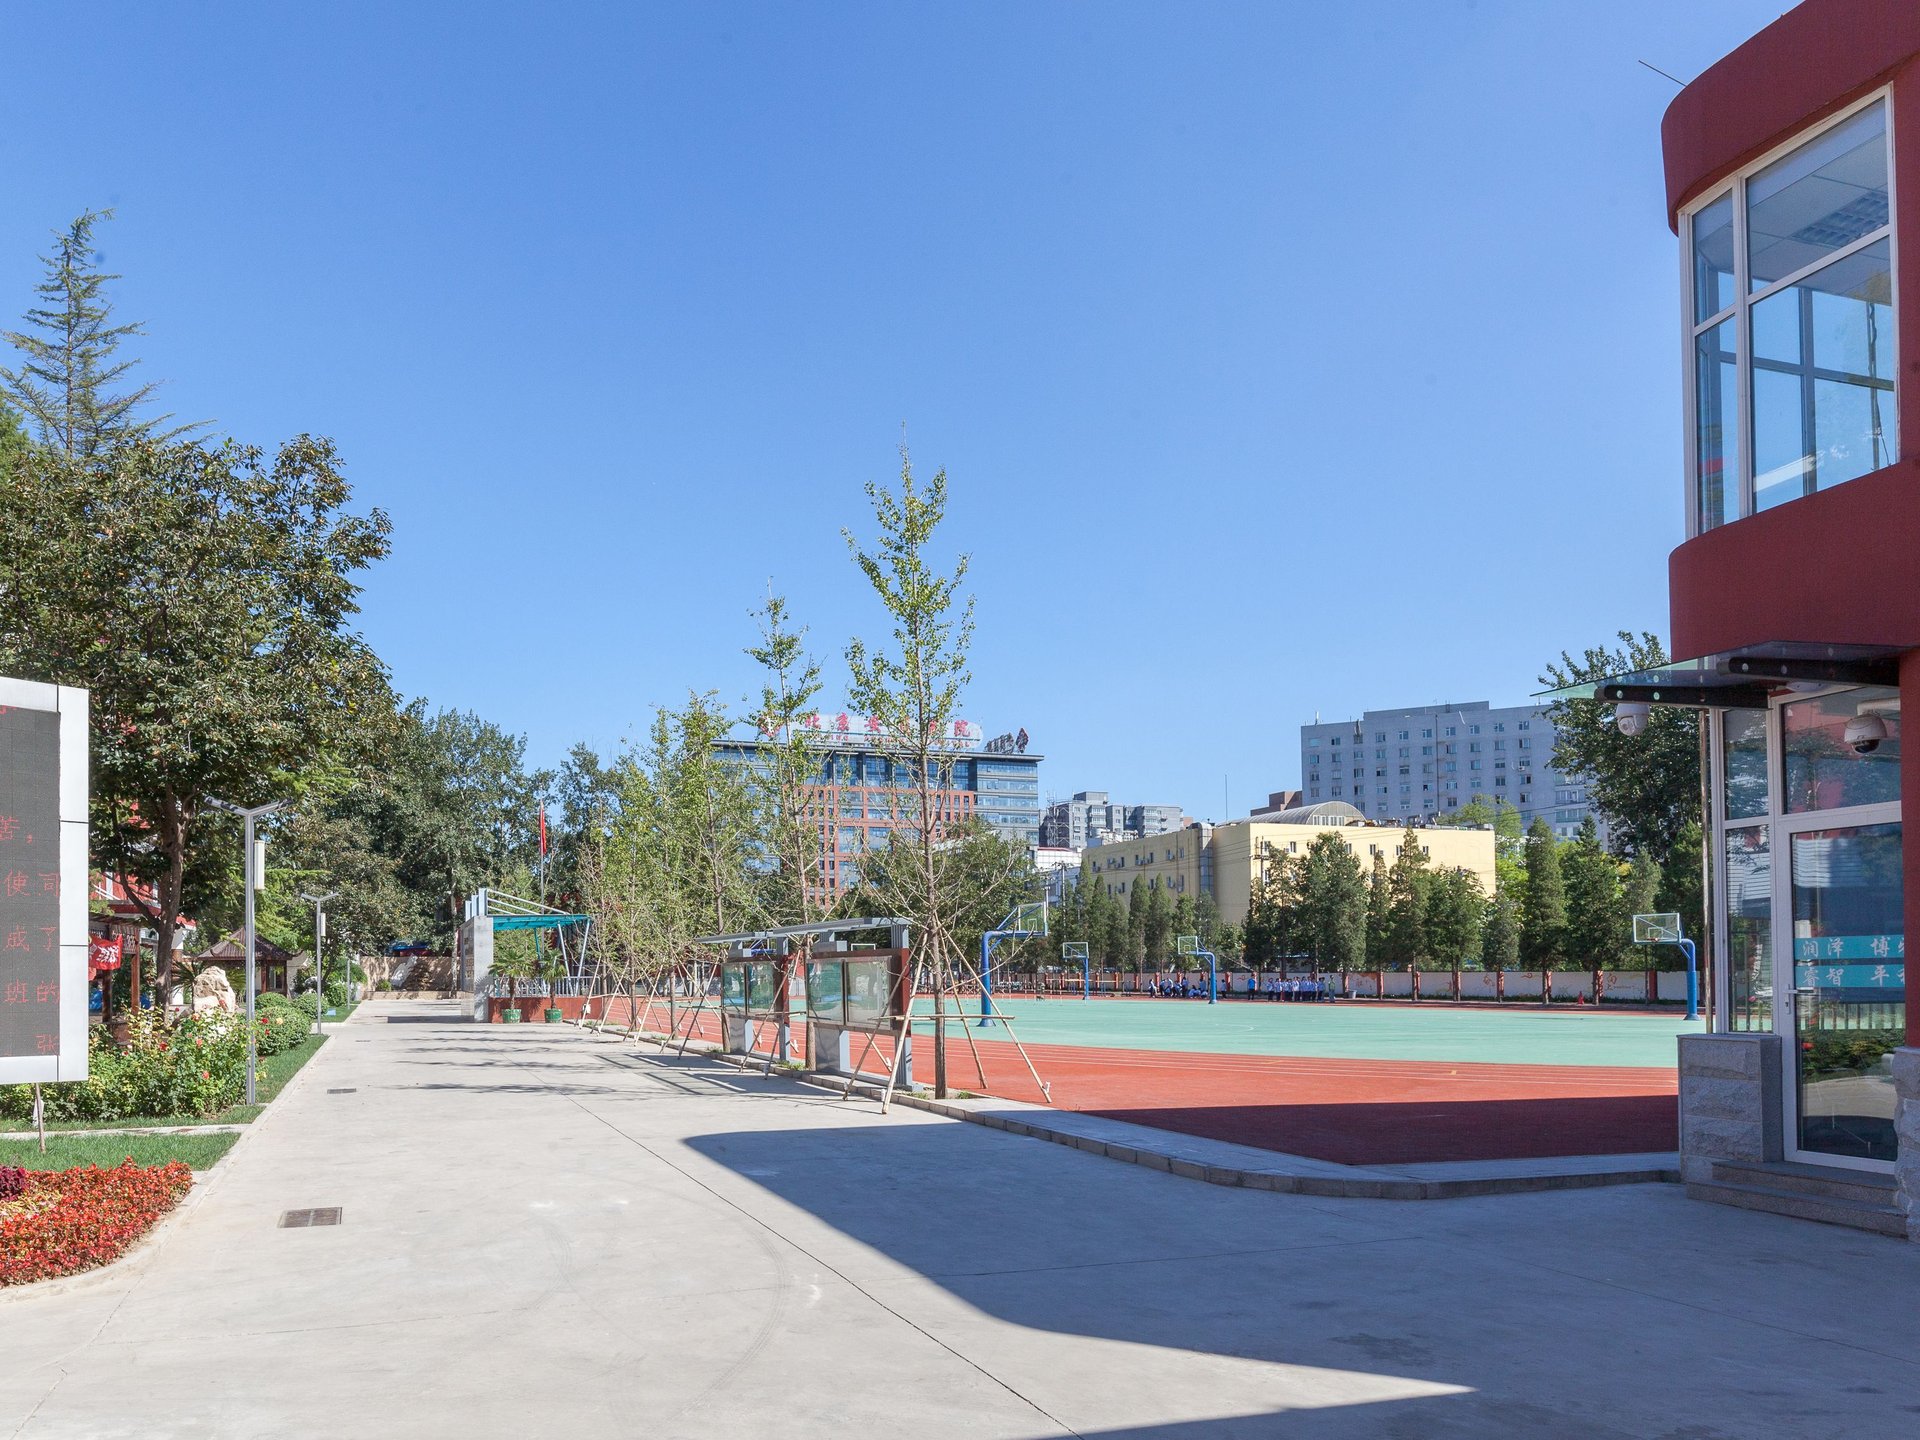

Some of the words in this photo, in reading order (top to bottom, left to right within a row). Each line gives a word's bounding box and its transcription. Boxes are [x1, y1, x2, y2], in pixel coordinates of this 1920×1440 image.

[1803, 938, 1843, 958] 润泽
[1870, 936, 1904, 957] 博
[1803, 967, 1844, 987] 睿智
[5, 979, 60, 1004] 班的
